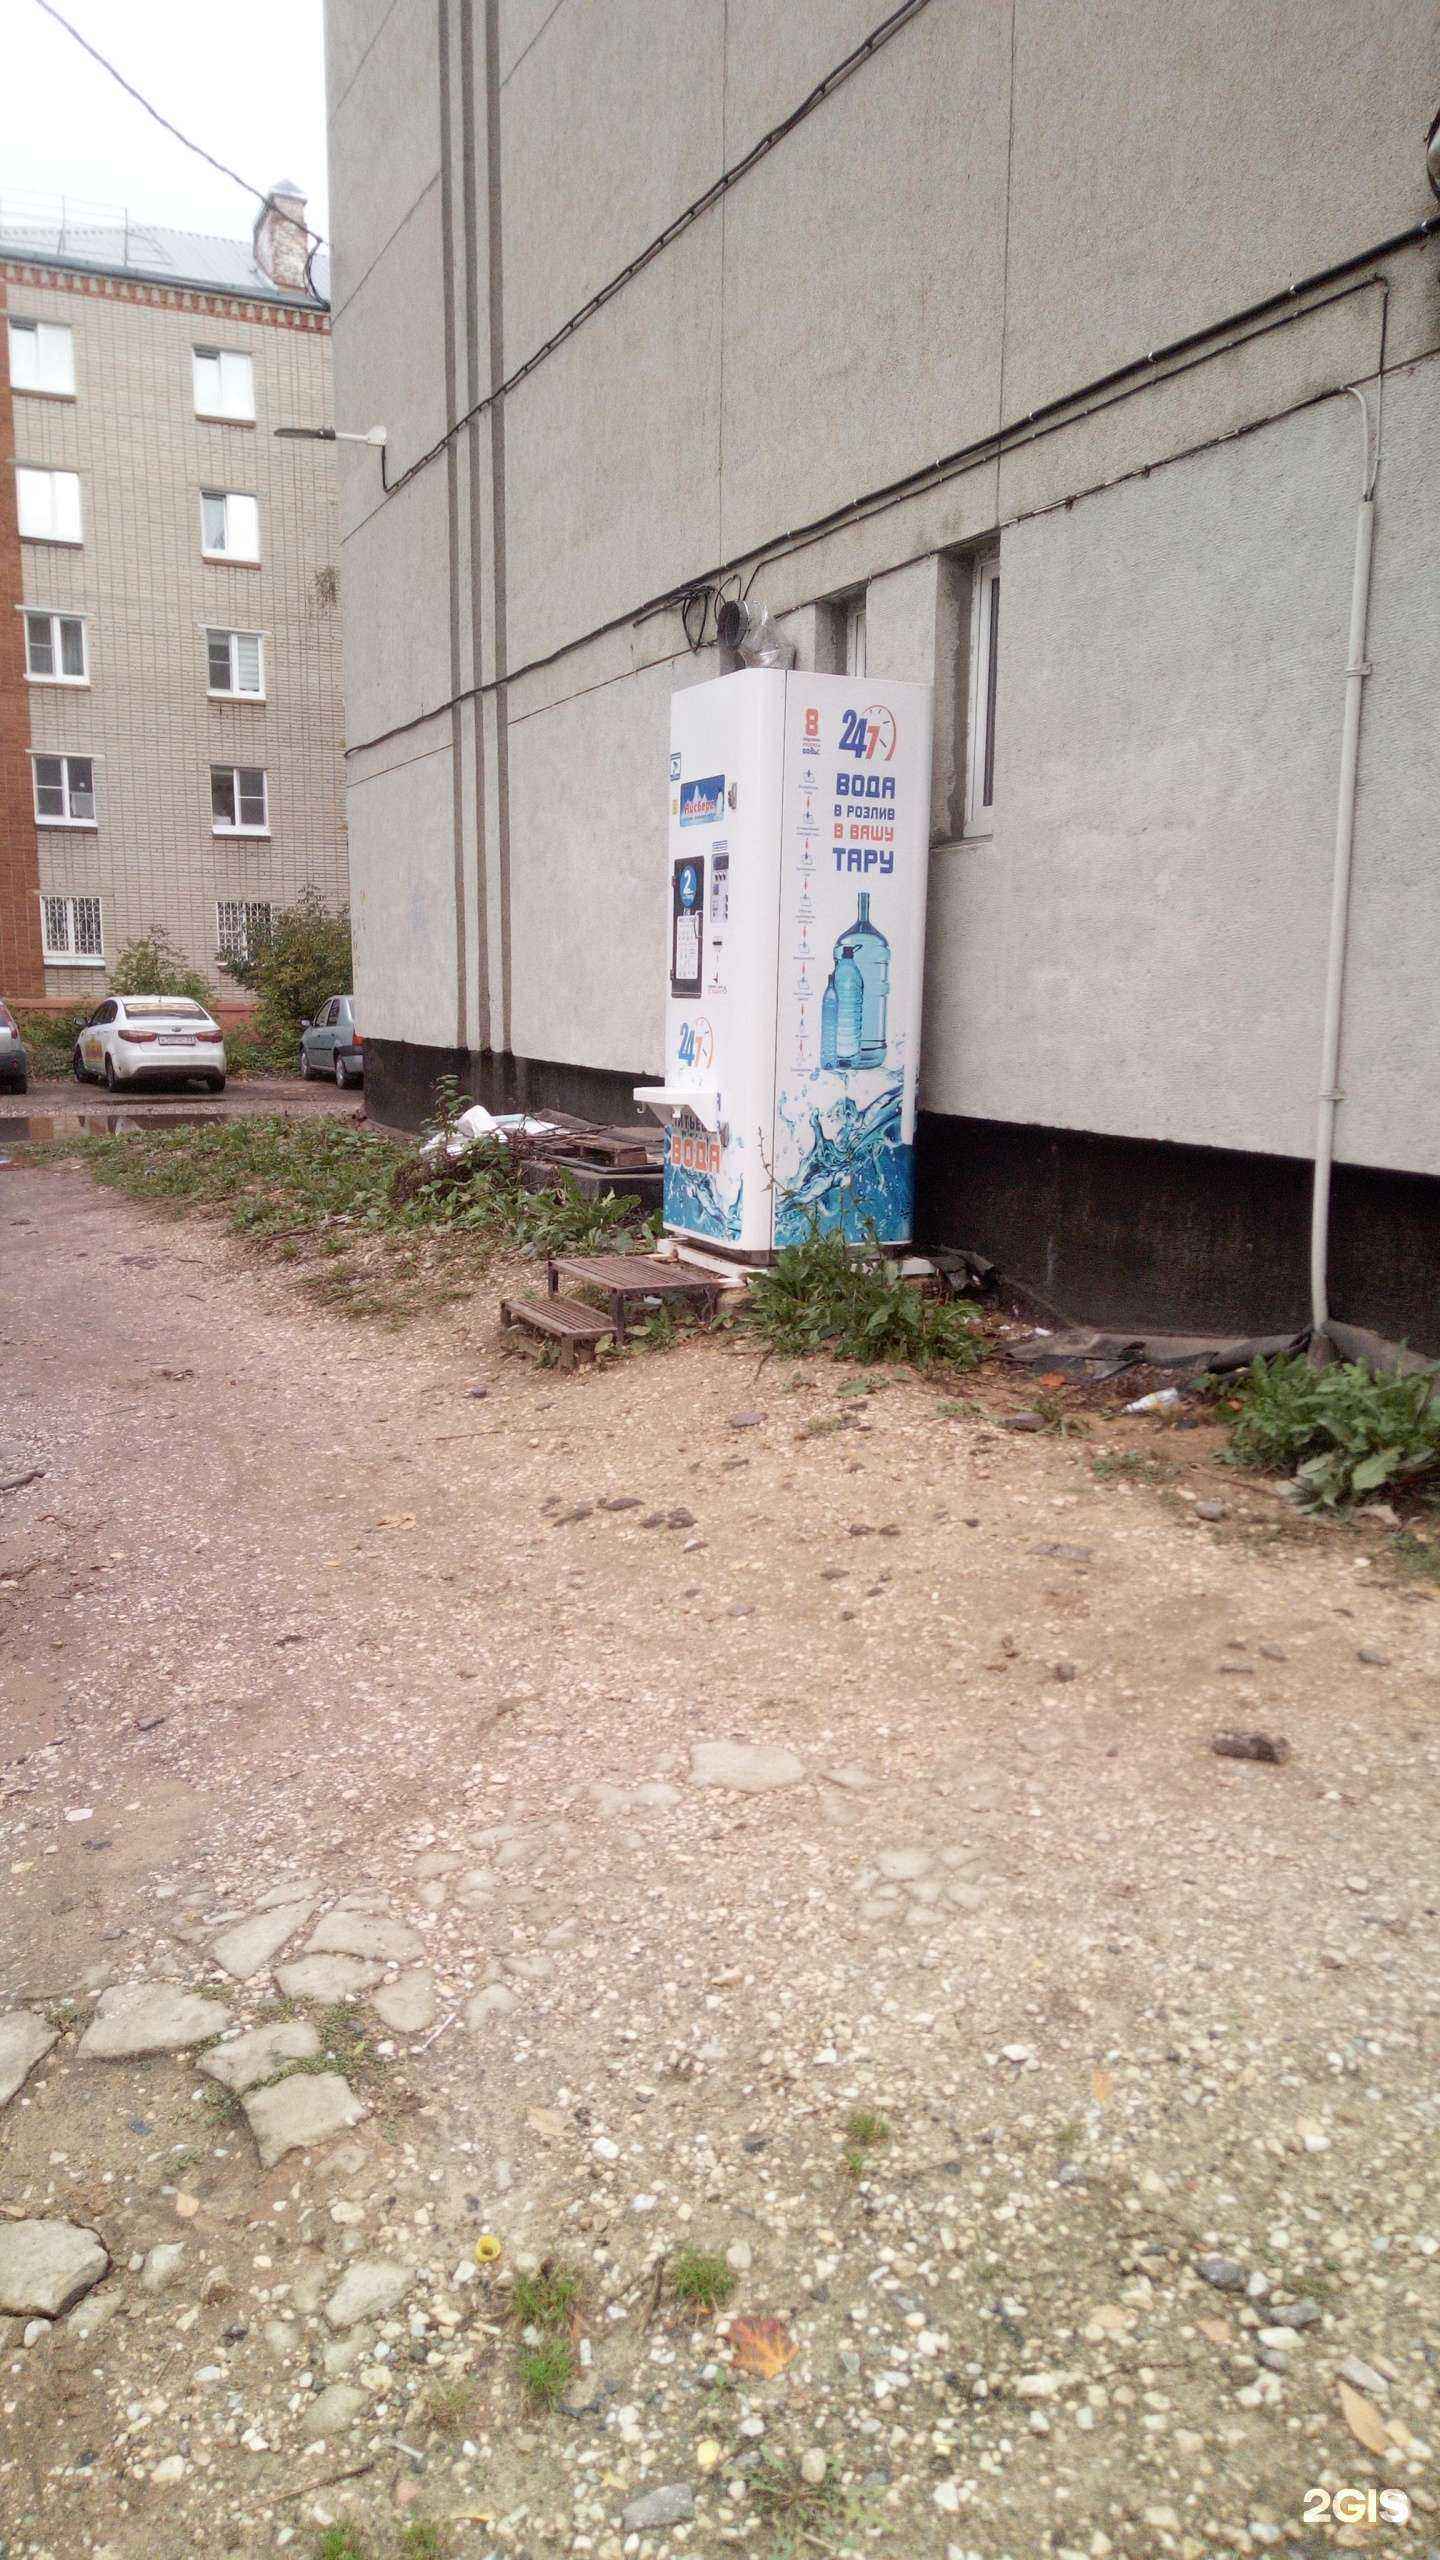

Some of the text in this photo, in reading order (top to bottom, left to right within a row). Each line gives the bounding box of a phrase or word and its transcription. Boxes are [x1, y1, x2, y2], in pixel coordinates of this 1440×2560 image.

[805, 708, 819, 736] 8
[836, 773, 896, 799] ВОДА
[834, 804, 895, 821] В РОЗЛИВ
[834, 823, 844, 839] В
[850, 824, 894, 842] ВАШУ
[832, 847, 895, 874] ТАРУ
[672, 1135, 721, 1173] ВОДА
